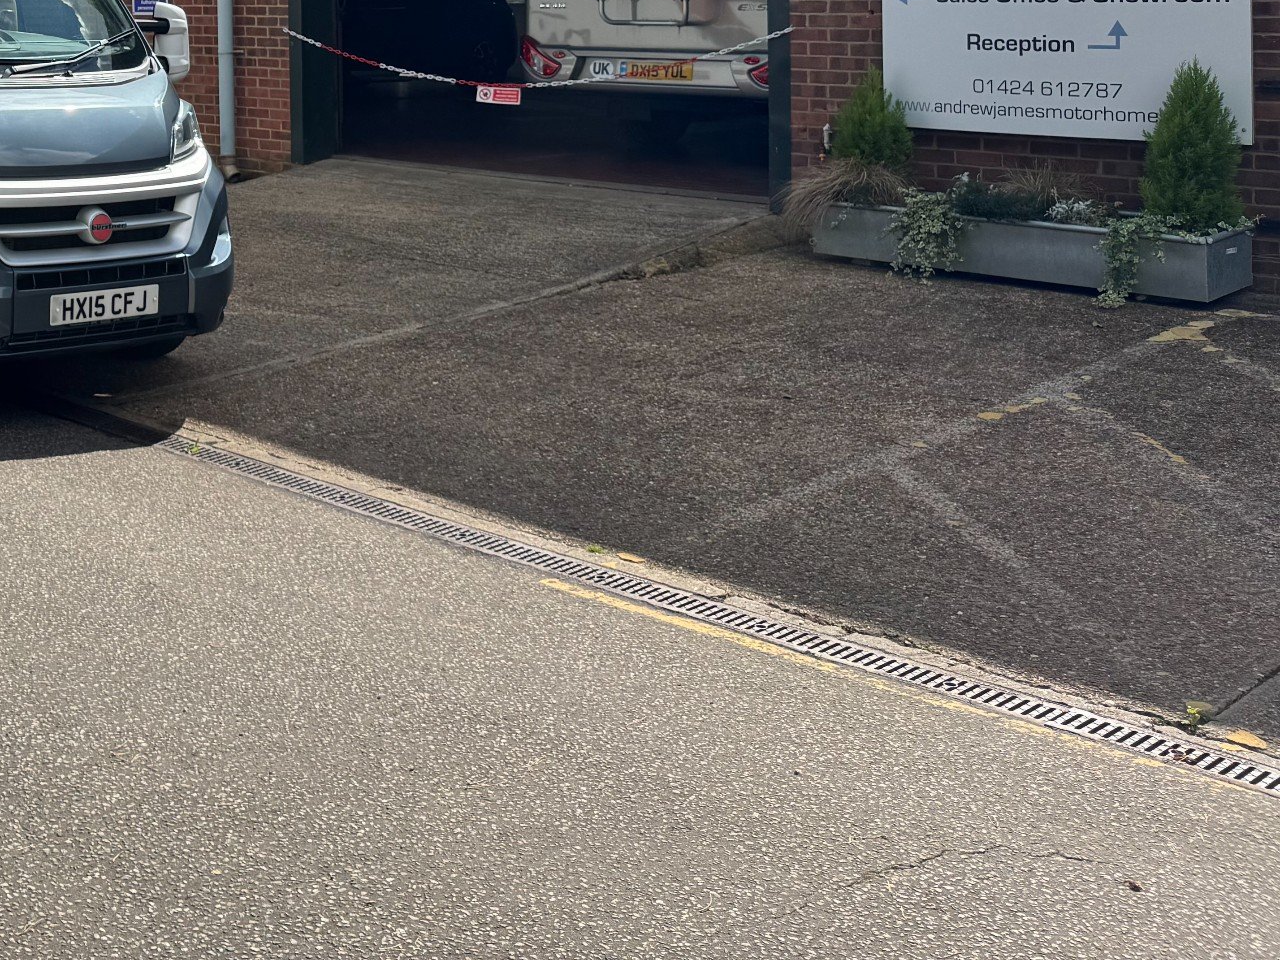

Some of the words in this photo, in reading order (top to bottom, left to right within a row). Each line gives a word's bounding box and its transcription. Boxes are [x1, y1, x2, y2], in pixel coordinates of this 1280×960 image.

[967, 33, 1075, 56] Reception
[593, 62, 610, 75] UK
[973, 79, 1035, 96] 01424
[1041, 81, 1123, 99] 612787
[897, 100, 1158, 123] www.andrewjamesmotorhome
[62, 295, 105, 321] HX15
[111, 290, 147, 315] CFJ
